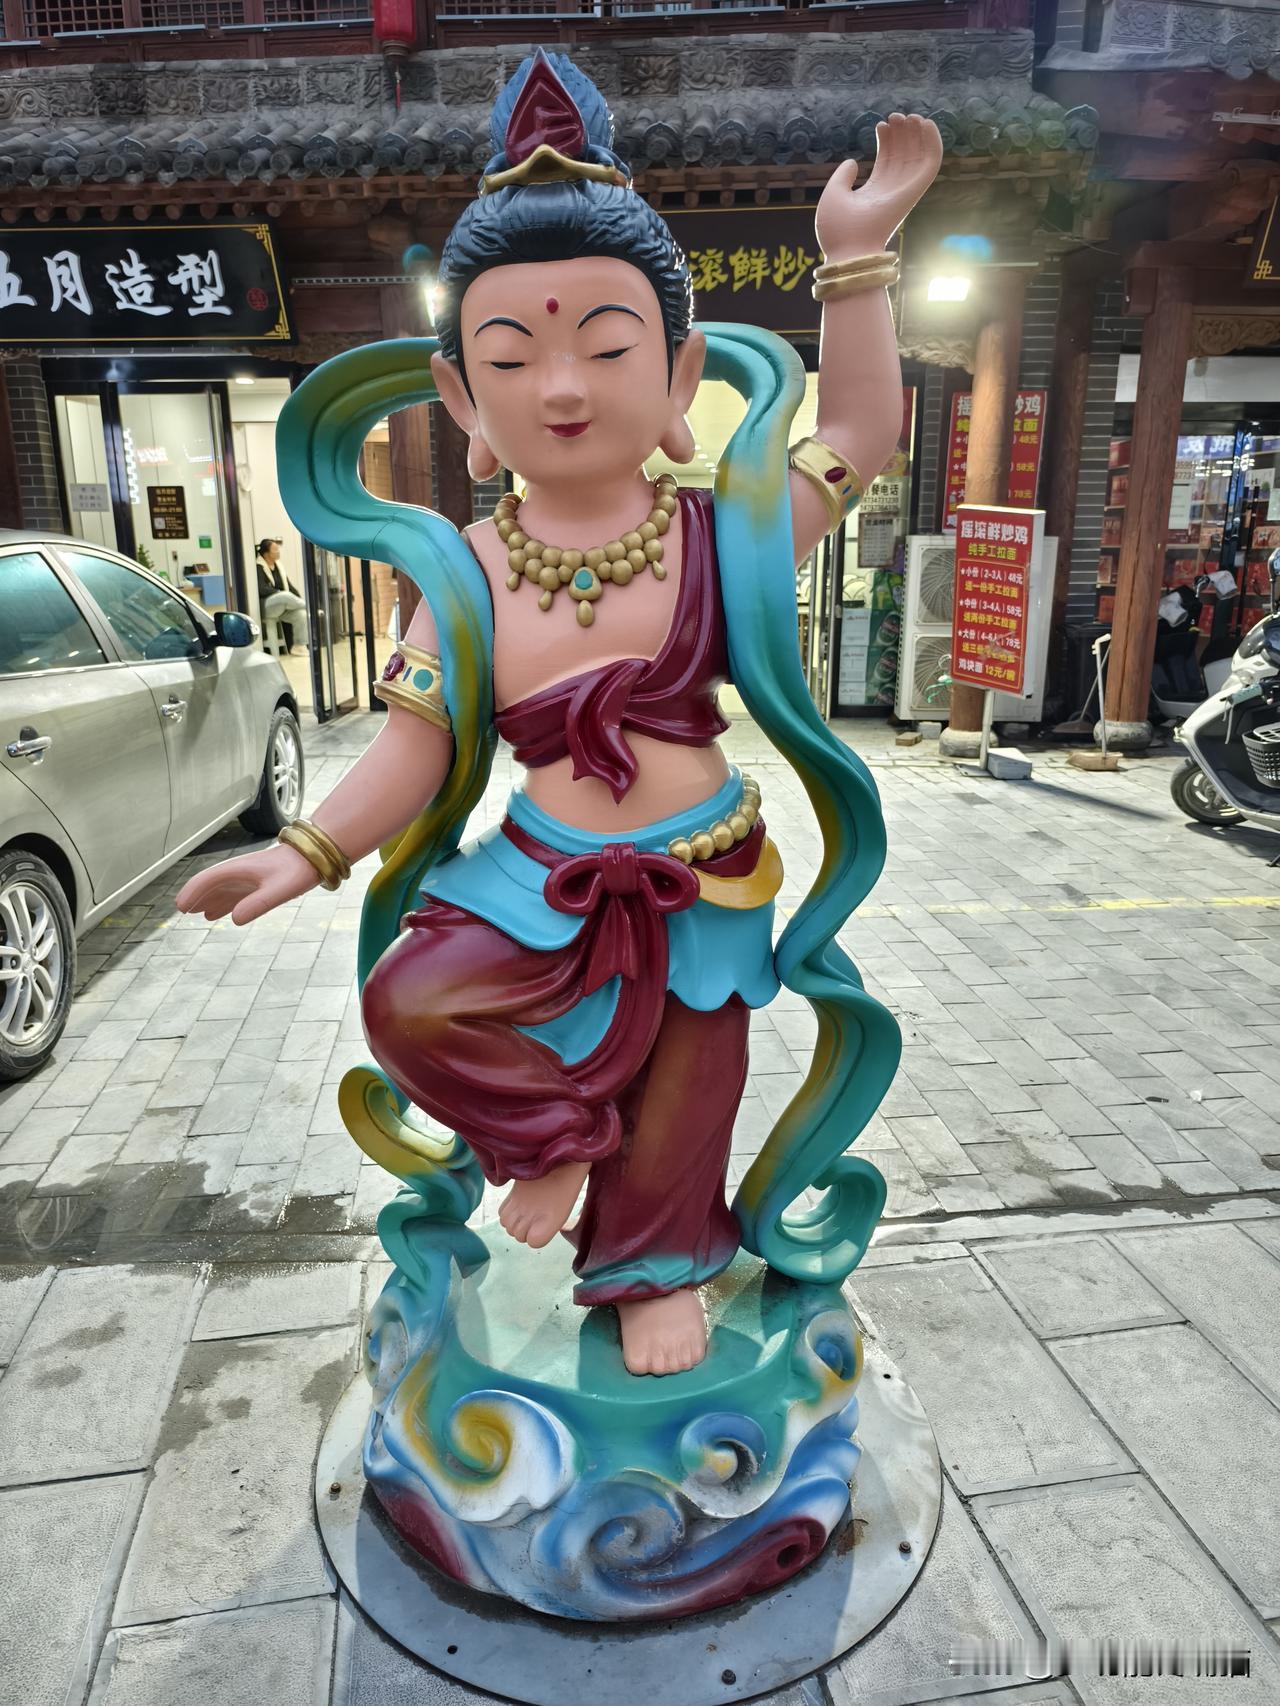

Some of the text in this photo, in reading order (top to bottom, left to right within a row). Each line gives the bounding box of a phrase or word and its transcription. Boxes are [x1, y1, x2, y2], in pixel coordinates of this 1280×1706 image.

[688, 245, 824, 293] 滚鲜炒
[961, 520, 1028, 545] 摇滚鲜炒鸡
